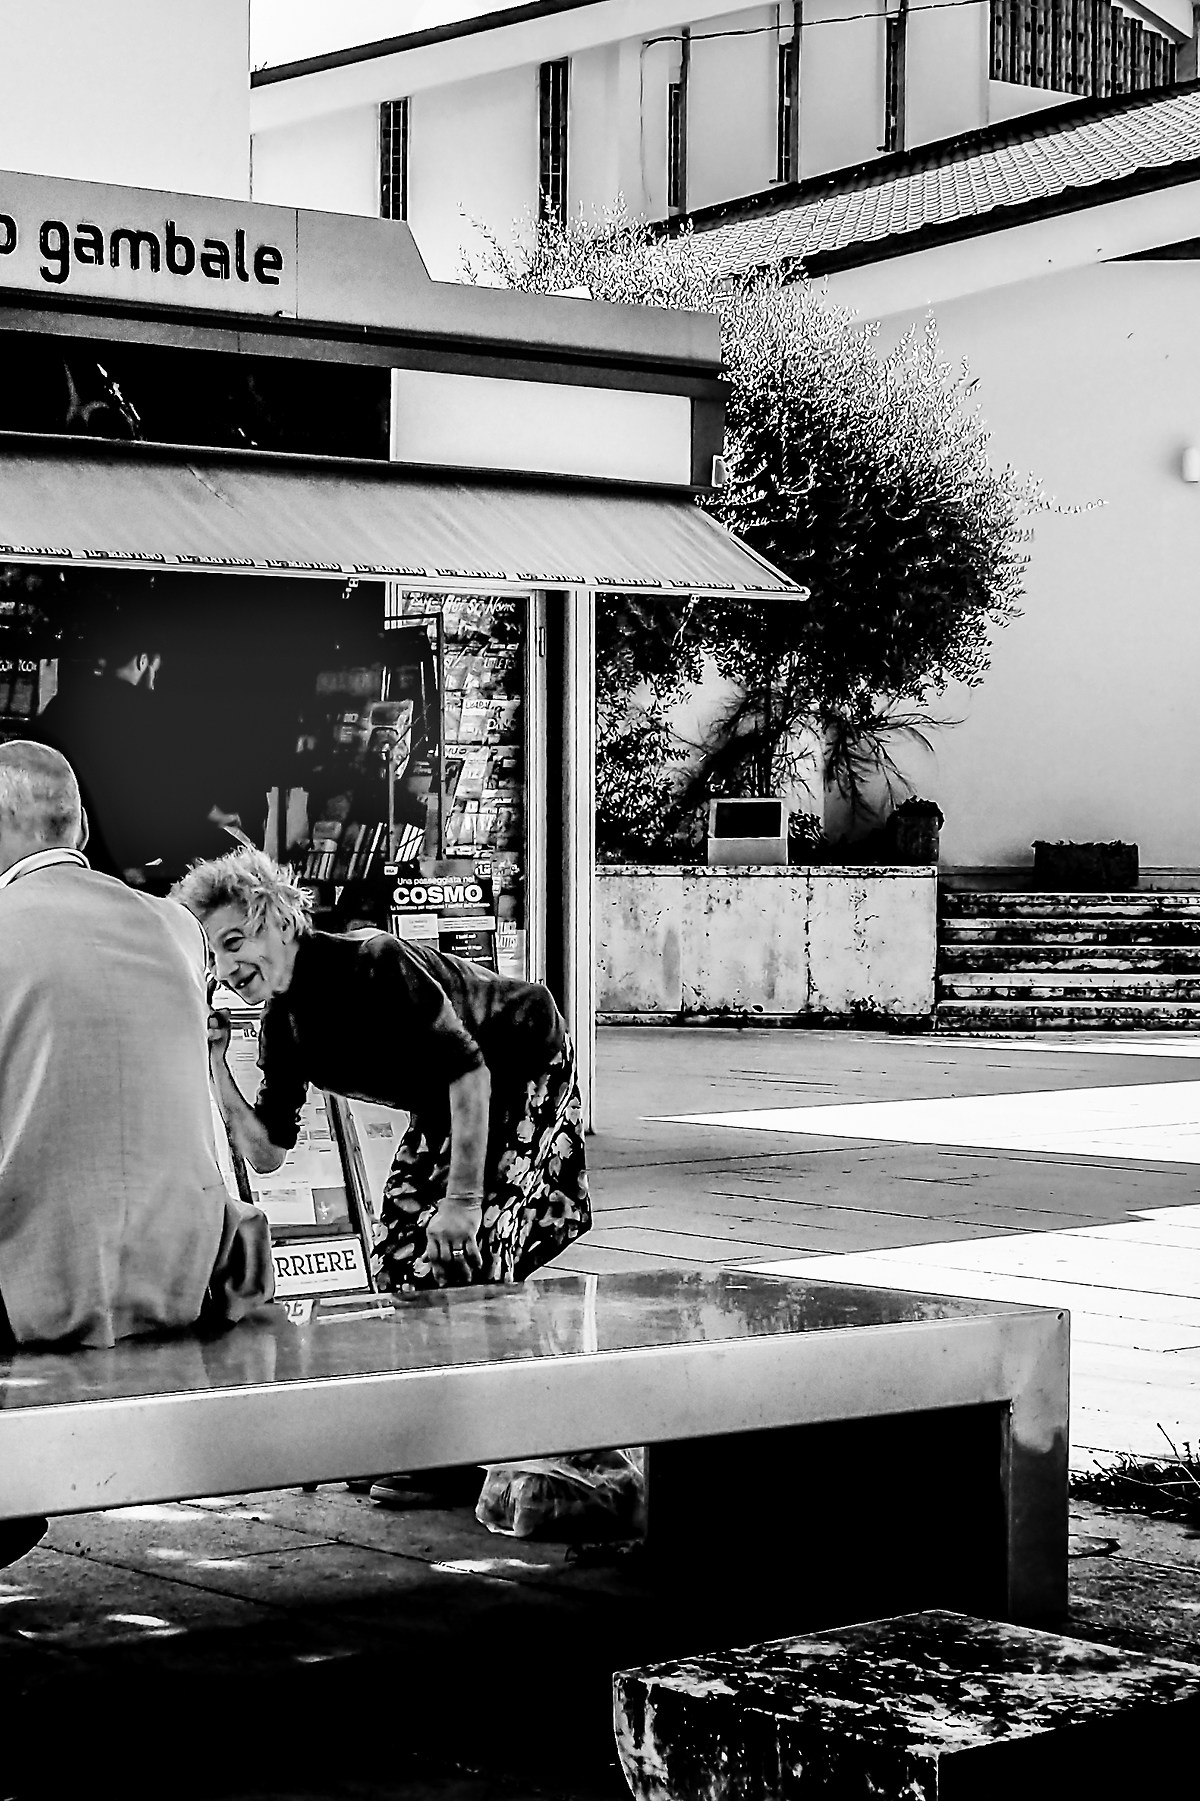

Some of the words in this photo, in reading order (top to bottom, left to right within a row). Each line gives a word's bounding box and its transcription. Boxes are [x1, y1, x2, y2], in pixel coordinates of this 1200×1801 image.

[38, 218, 285, 286] gambale
[393, 884, 483, 904] COSMO
[274, 1249, 357, 1278] RRIERE
